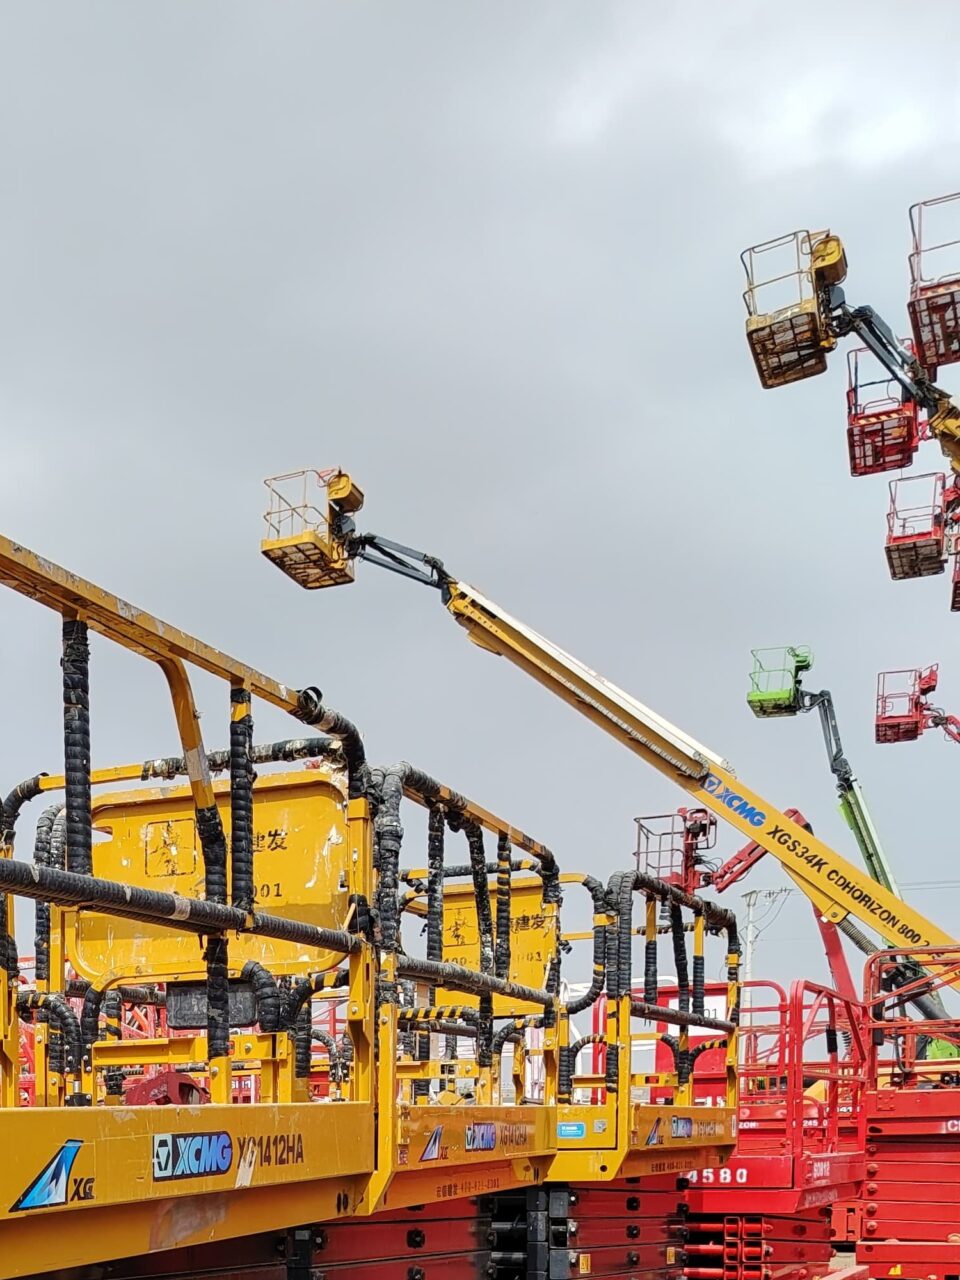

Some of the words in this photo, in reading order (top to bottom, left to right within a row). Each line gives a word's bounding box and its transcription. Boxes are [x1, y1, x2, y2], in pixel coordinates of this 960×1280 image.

[714, 786, 767, 827] XCMG
[766, 825, 829, 873] XGS34K
[826, 870, 901, 928] CDHORIZON
[897, 924, 922, 944] 800
[173, 1134, 233, 1176] XCMG
[686, 1168, 748, 1184] 4580
